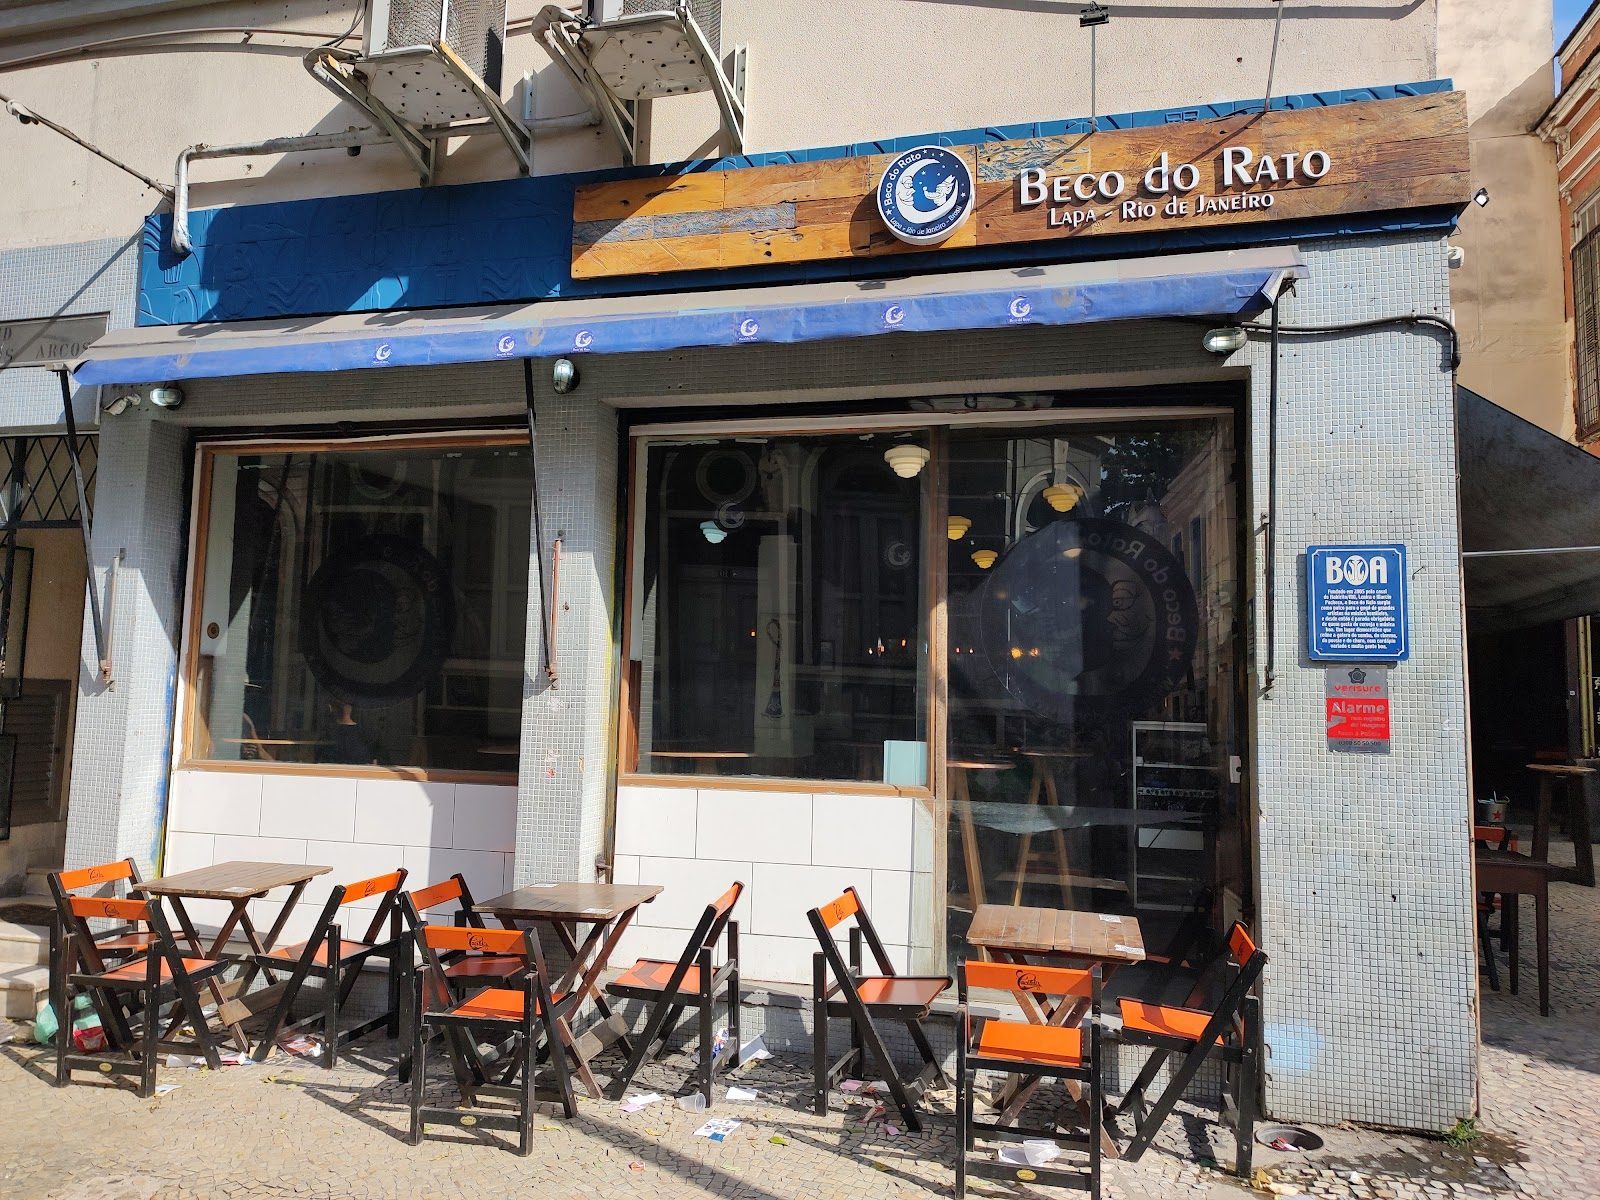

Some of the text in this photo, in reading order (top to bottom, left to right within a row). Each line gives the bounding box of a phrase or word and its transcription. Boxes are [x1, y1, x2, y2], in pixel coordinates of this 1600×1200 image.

[884, 153, 922, 206] Beco do Rato
[1144, 151, 1201, 194] do
[906, 226, 916, 234] Rio
[925, 221, 947, 235] Janeiro
[948, 204, 963, 222] Brasil
[1332, 701, 1386, 714] Alarme
